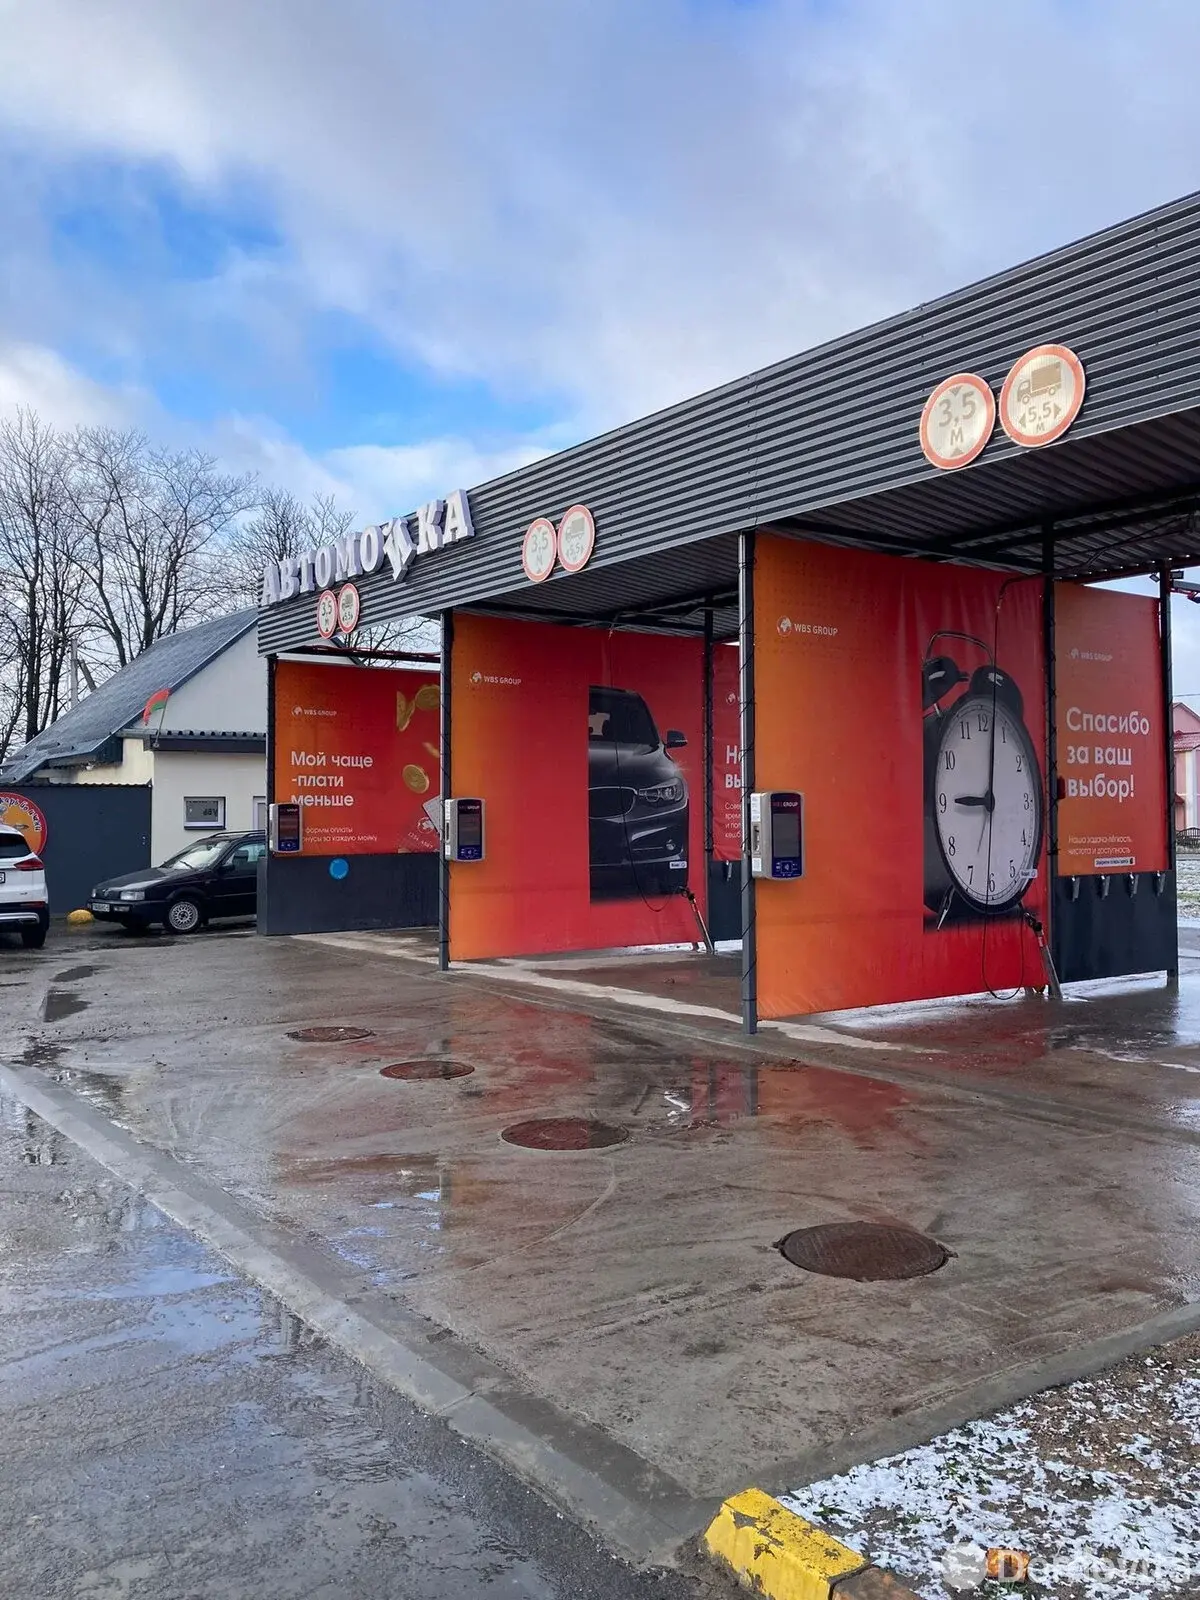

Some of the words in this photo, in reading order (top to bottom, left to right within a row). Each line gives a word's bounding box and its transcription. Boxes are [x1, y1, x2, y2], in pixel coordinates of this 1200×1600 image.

[938, 390, 977, 428] 3,5
[793, 622, 812, 635] WBS
[812, 624, 838, 638] GROUP
[483, 675, 499, 684] WBS
[499, 676, 522, 686] GROUP
[1066, 706, 1150, 736] Спасибо
[290, 750, 327, 767] Мой
[331, 754, 374, 769] чаще
[1066, 745, 1089, 765] за
[1094, 746, 1132, 766] ваш
[291, 774, 344, 788] -плати
[1068, 772, 1136, 804] выбор!
[290, 793, 354, 807] меньше
[939, 793, 948, 814] 9
[1023, 793, 1030, 811] 3
[330, 826, 354, 834] оплаты
[1020, 829, 1027, 846] 4
[948, 836, 956, 856] 8
[967, 865, 974, 885] 7
[1009, 859, 1016, 878] 5
